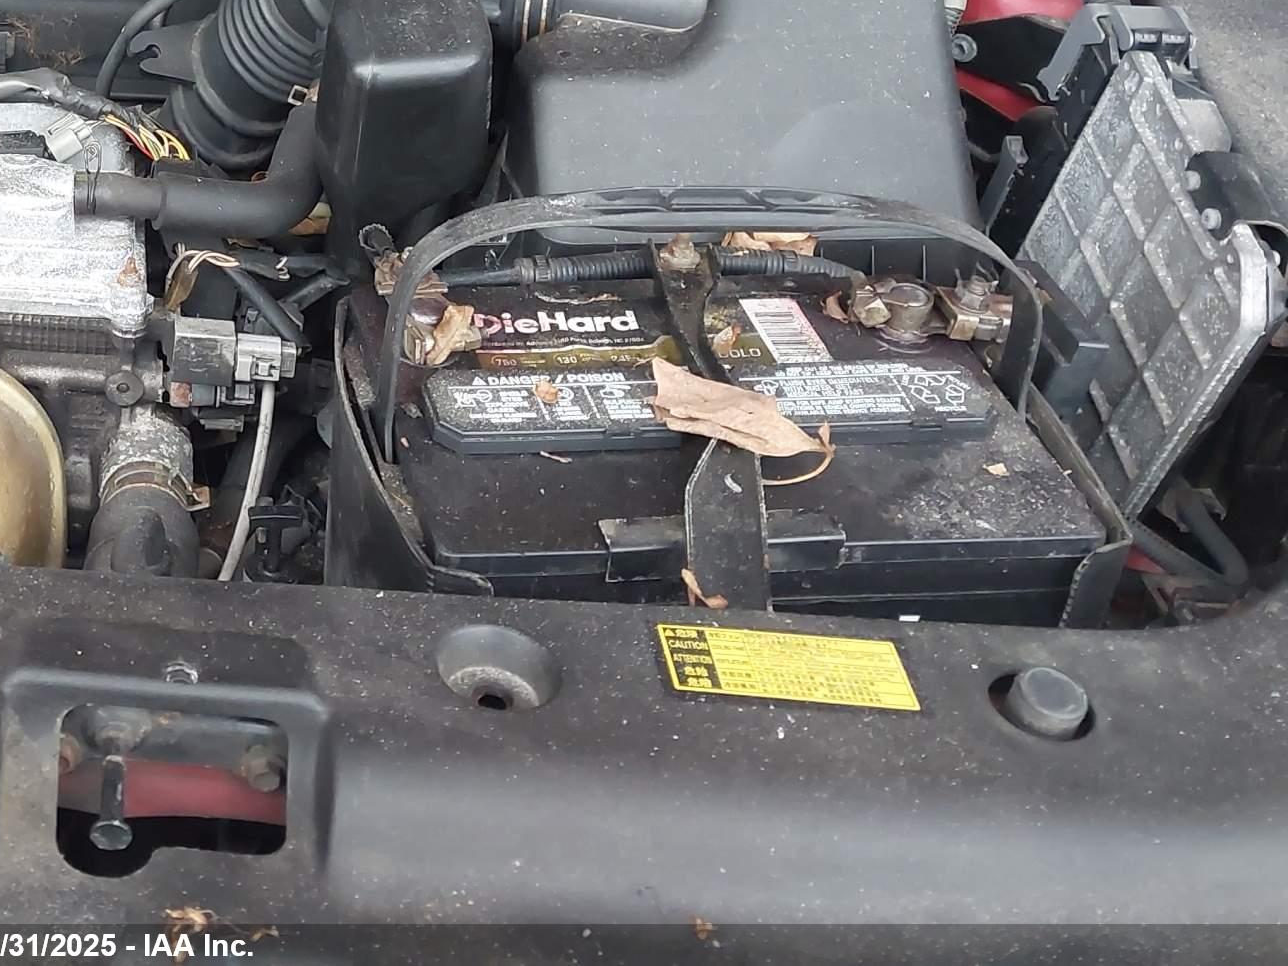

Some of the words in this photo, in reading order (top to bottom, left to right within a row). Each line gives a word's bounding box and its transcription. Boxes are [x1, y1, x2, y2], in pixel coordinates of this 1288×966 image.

[473, 310, 640, 335] DieHard
[488, 375, 551, 386] DANGER
[567, 372, 626, 382] POISON
[668, 639, 709, 650] CAUTION
[673, 653, 713, 664] ATTENTION
